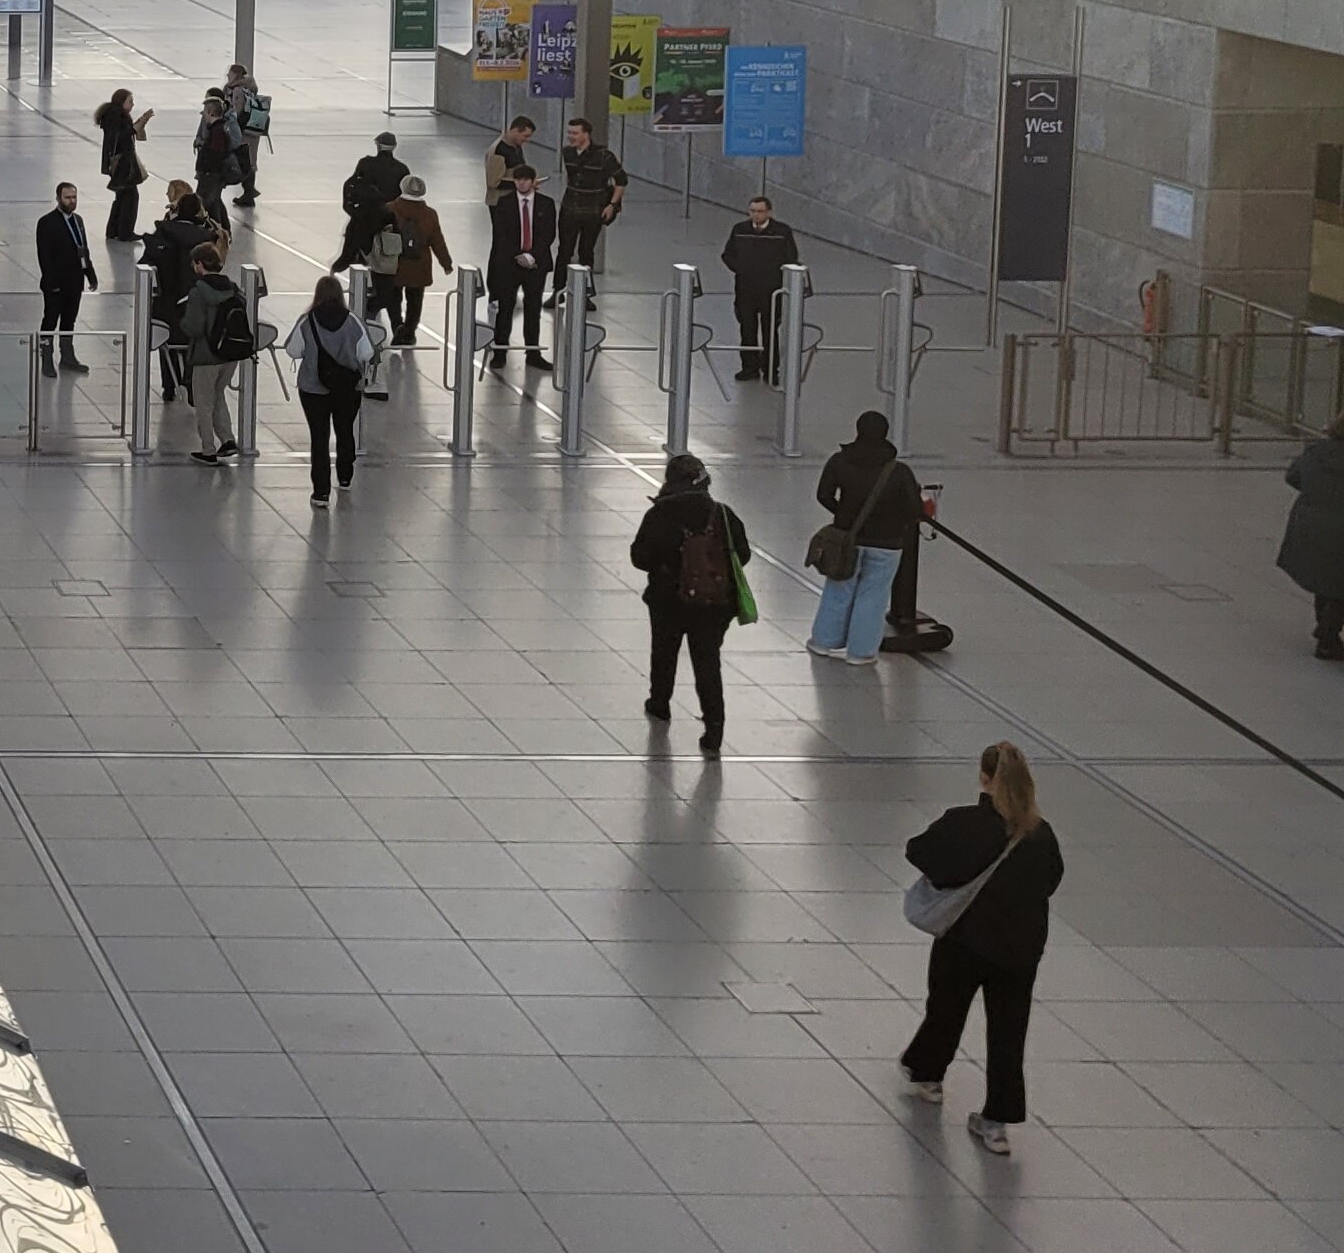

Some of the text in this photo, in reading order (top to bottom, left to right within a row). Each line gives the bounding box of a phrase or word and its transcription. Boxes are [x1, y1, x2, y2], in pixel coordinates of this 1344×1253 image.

[538, 33, 577, 50] Leipz
[537, 48, 571, 62] liest
[1025, 118, 1063, 133] West
[1024, 133, 1031, 148] 1
